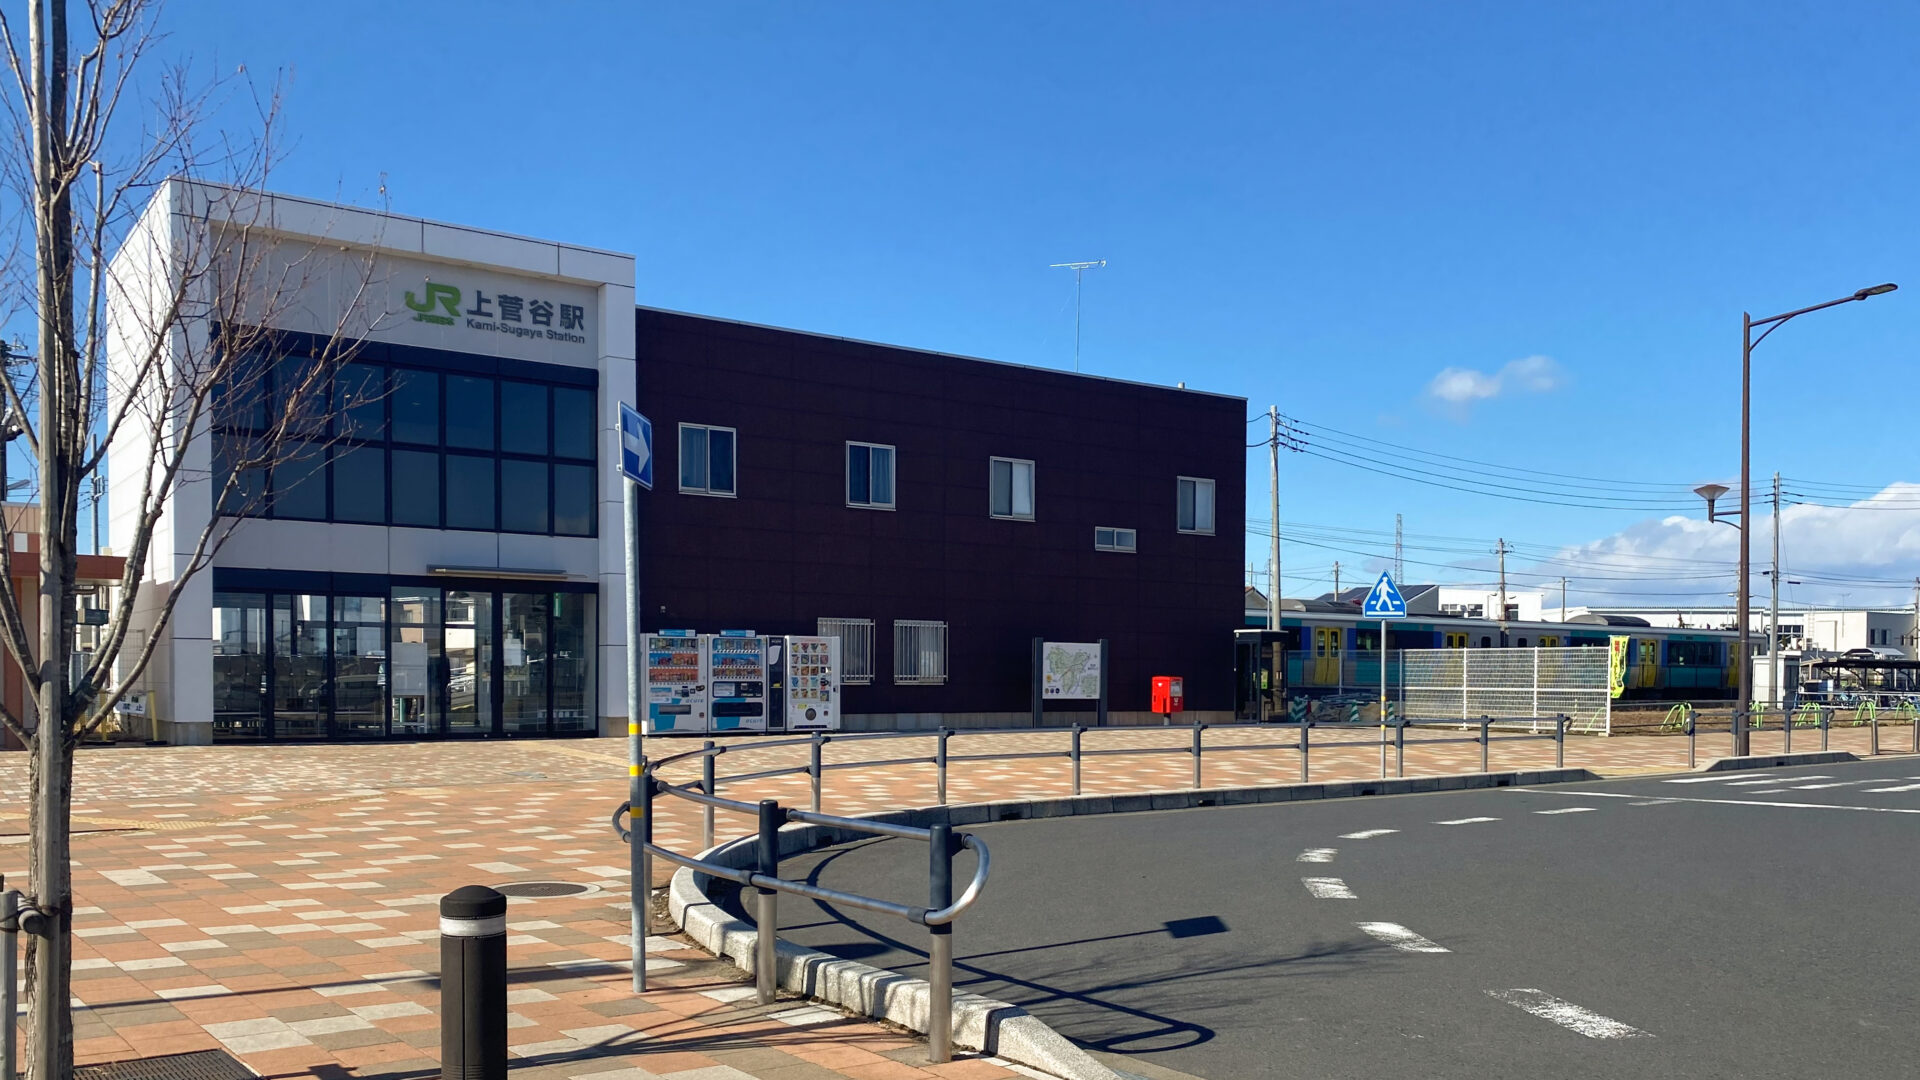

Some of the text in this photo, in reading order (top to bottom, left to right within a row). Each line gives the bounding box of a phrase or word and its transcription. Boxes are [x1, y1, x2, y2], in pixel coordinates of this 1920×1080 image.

[404, 282, 462, 317] JR
[466, 290, 585, 331] 上菅谷駅
[466, 318, 543, 338] Kami-Sugaya
[546, 329, 585, 344] Station
